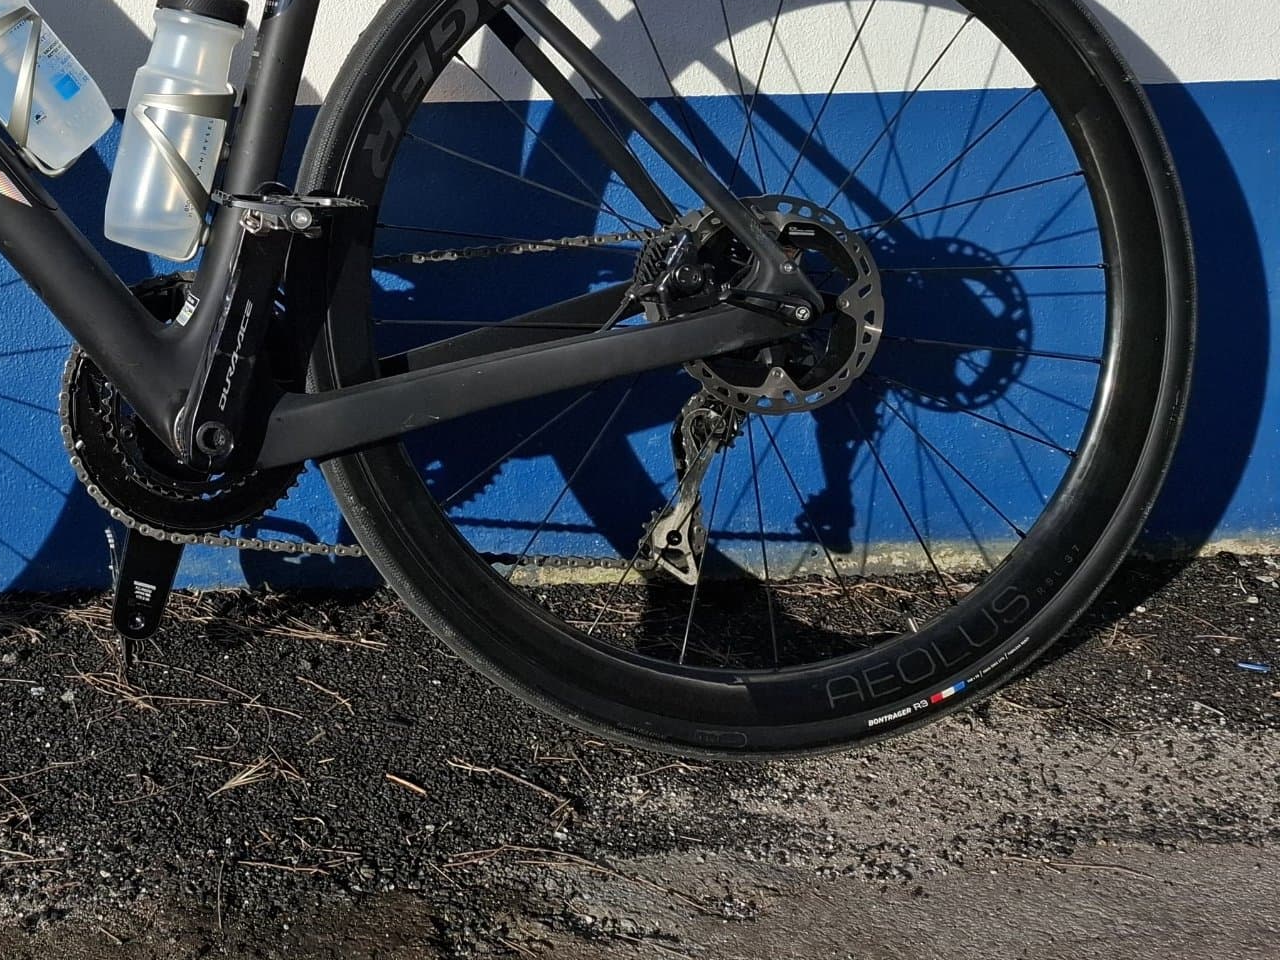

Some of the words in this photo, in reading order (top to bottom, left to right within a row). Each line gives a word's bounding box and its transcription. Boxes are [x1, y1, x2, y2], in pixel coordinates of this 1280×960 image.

[219, 298, 254, 411] DURA-ACE
[825, 585, 1030, 709] AEOLUS
[868, 707, 912, 727] BONTRAGER
[913, 699, 929, 711] R3
